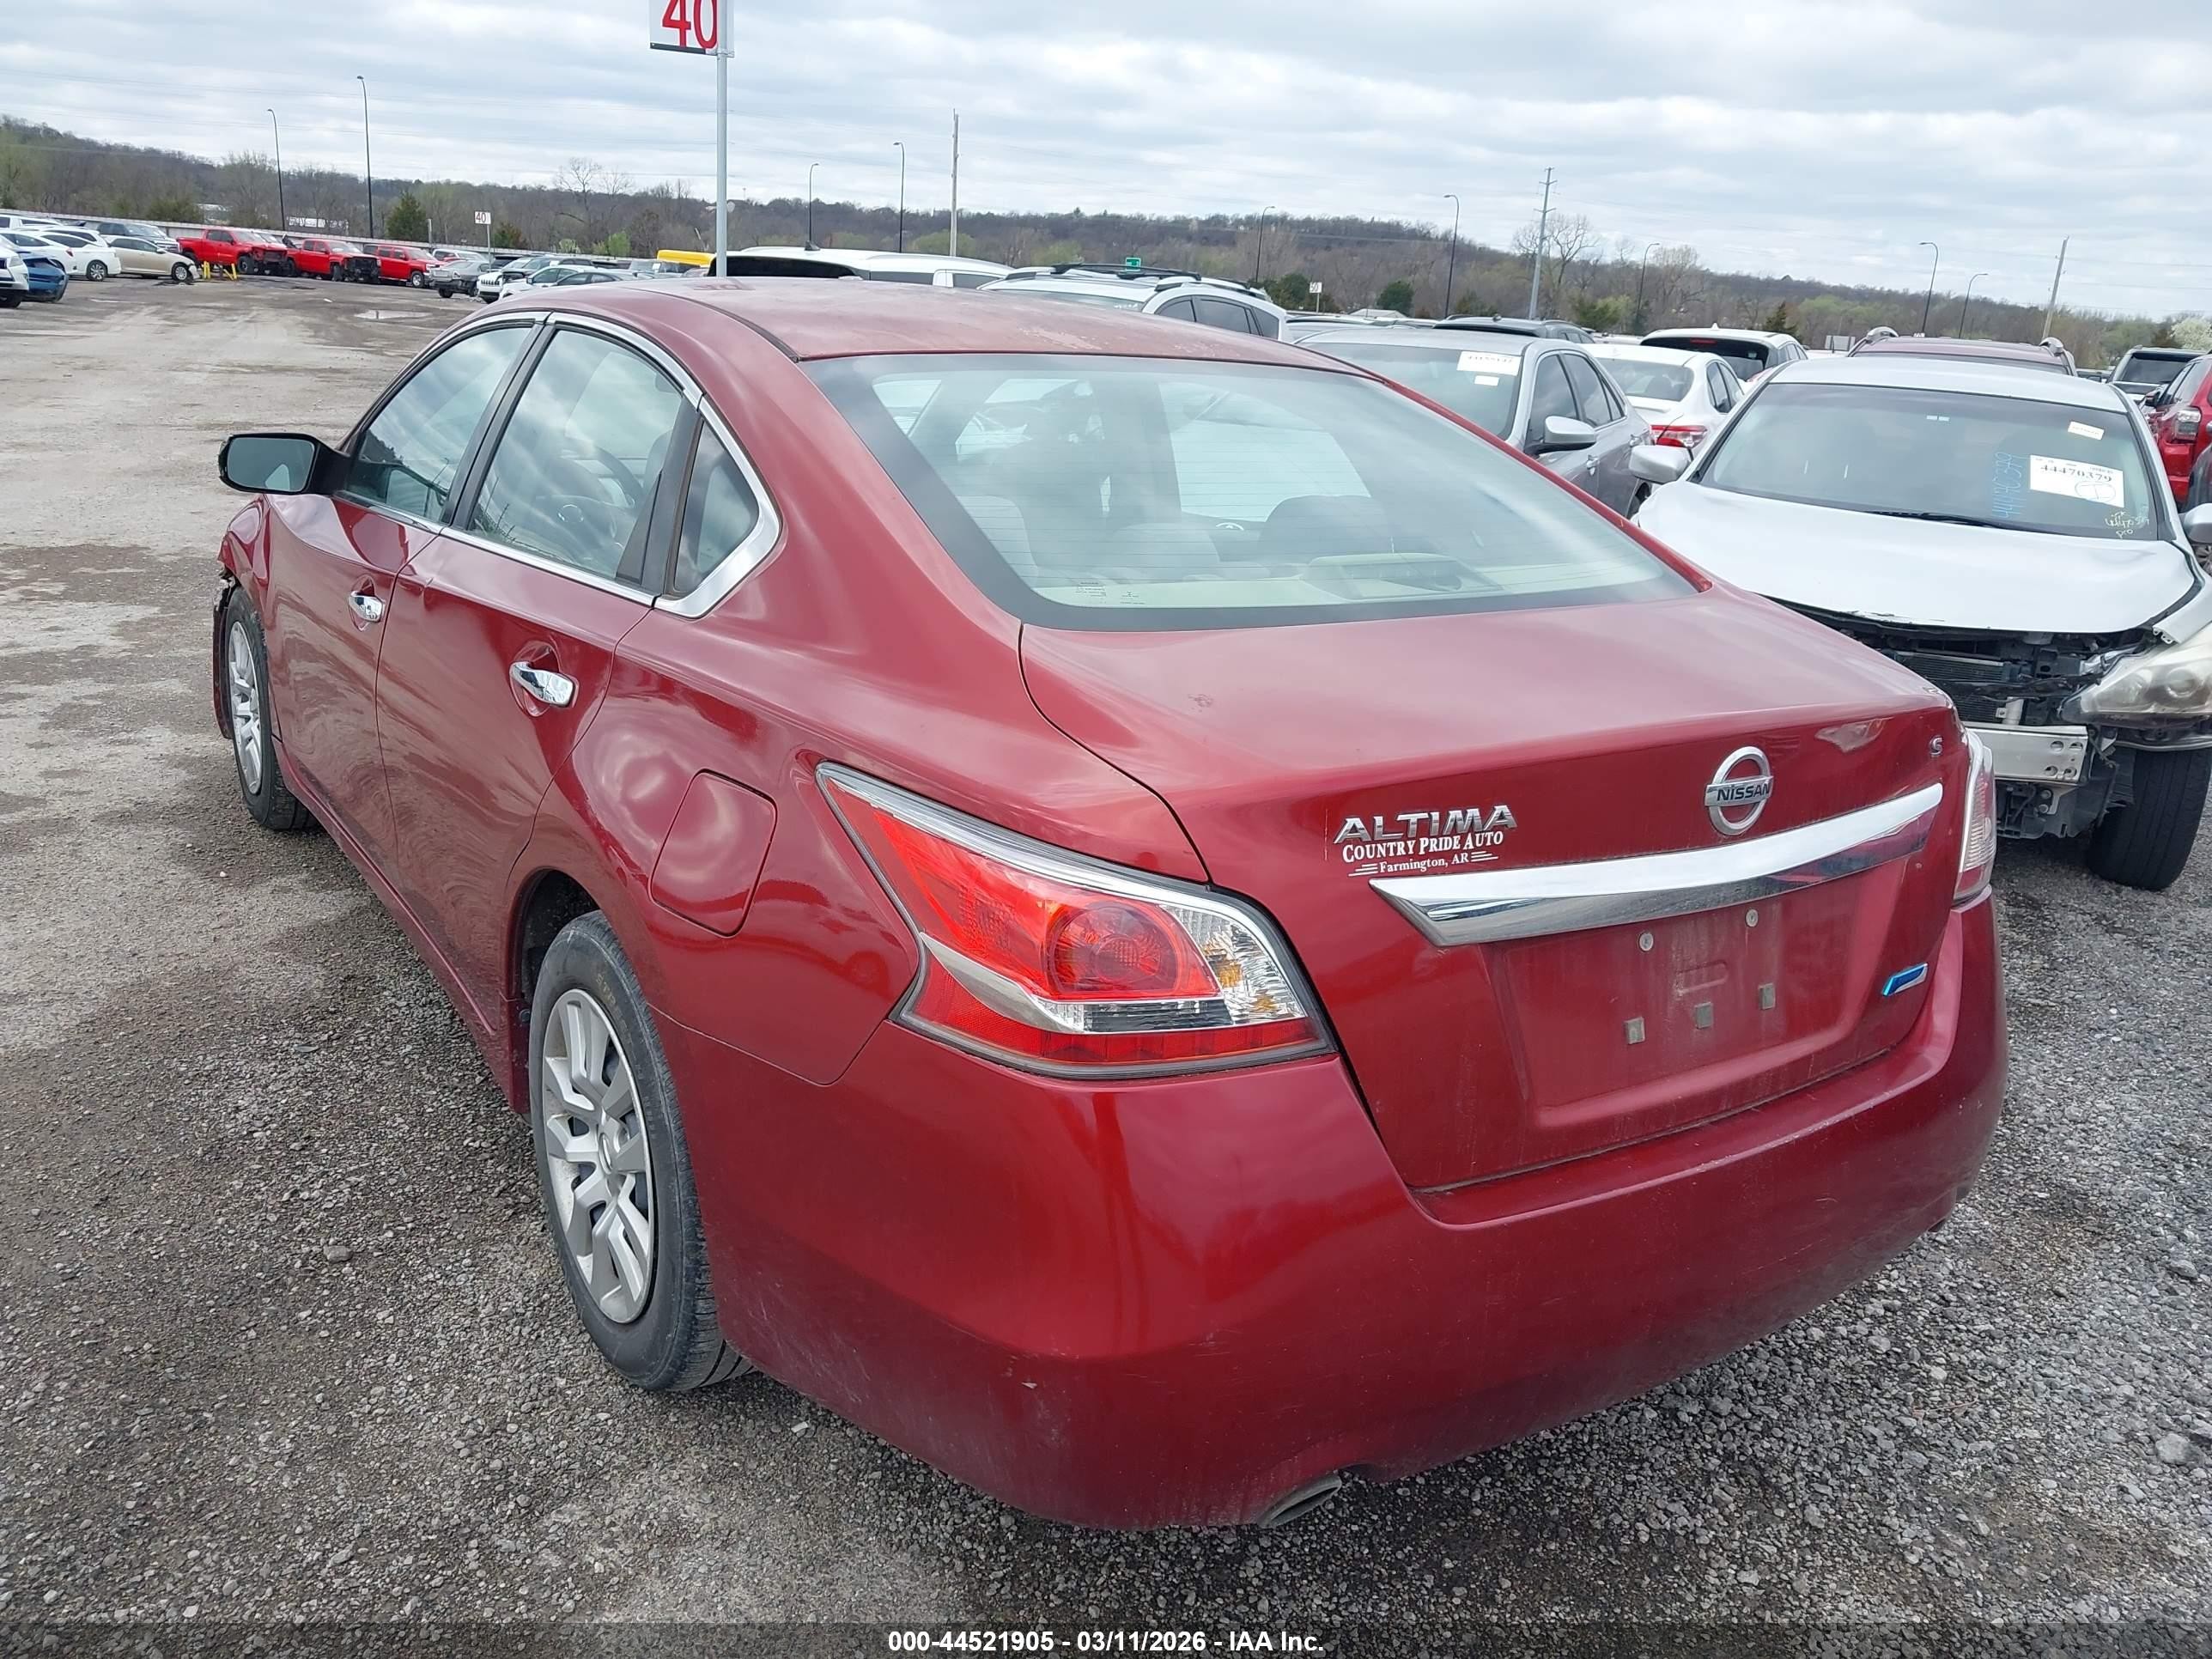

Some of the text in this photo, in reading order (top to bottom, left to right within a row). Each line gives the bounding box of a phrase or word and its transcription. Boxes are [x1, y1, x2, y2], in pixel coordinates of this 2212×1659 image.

[662, 0, 718, 49] 40
[476, 211, 487, 222] 40
[2041, 465, 2112, 482] 44470379
[1929, 735, 1943, 757] S
[1717, 782, 1771, 801] NISSAN
[1333, 805, 1518, 844] ALTIMA
[1342, 830, 1503, 863] COUNTRY PRIDE AUTO
[1379, 852, 1470, 873] Farmington, AR
